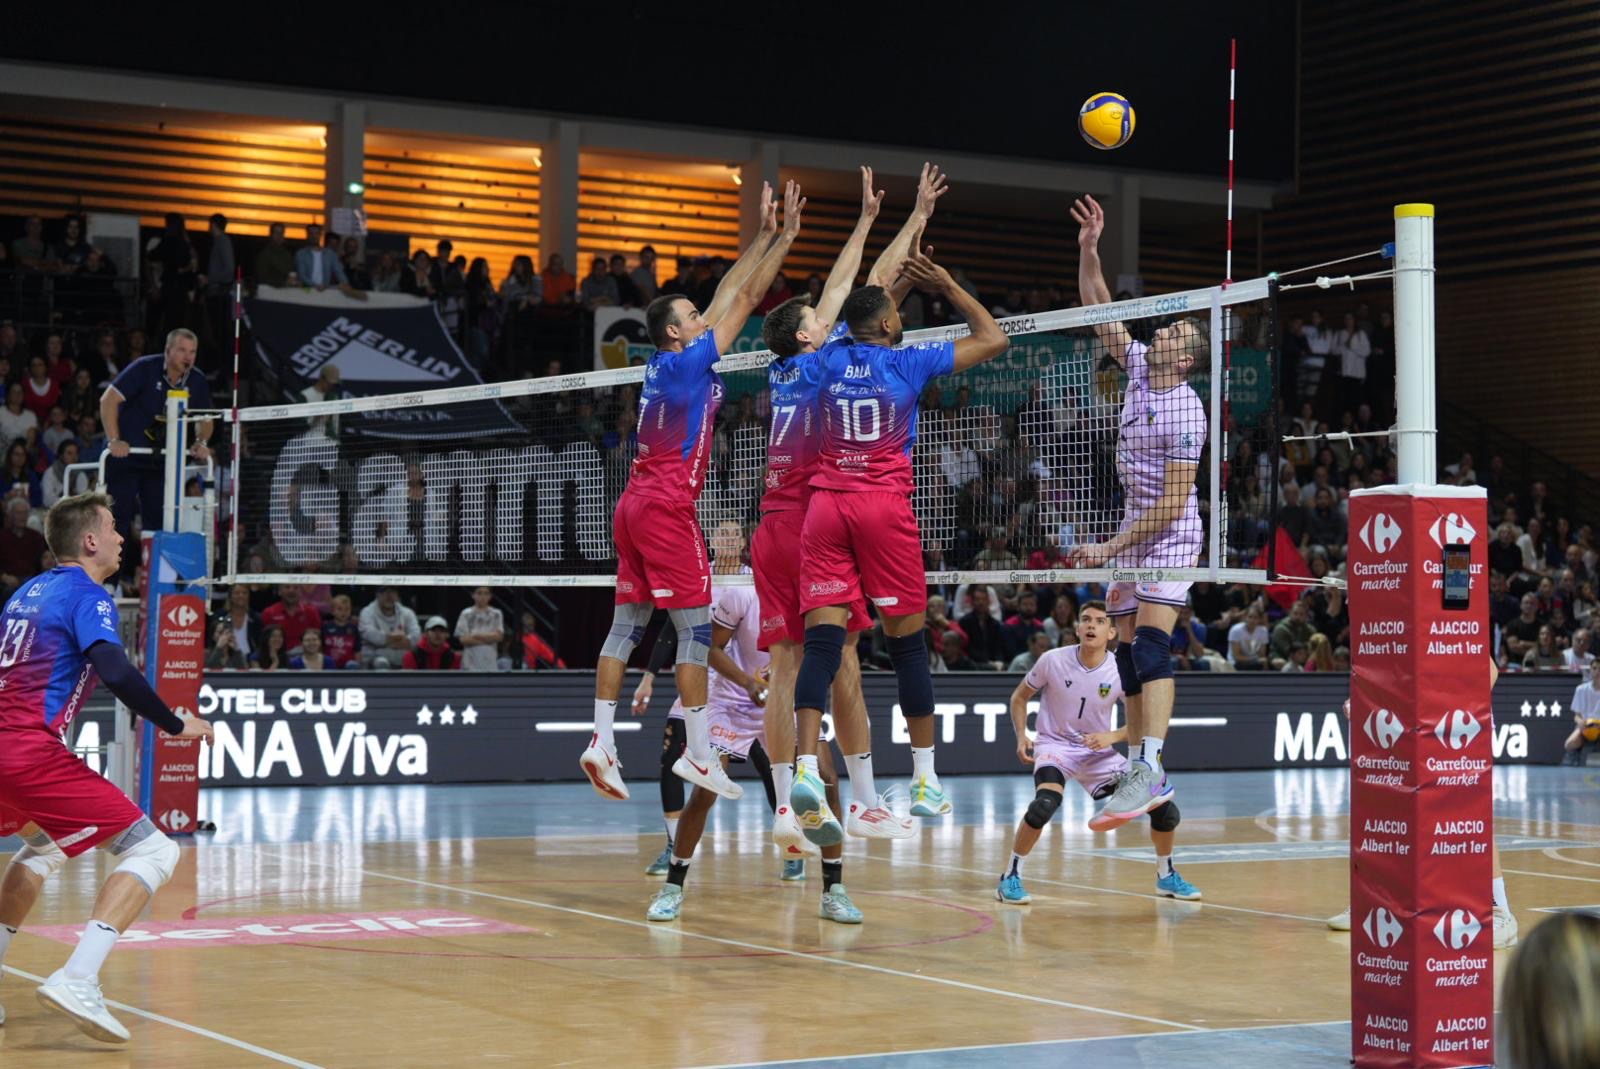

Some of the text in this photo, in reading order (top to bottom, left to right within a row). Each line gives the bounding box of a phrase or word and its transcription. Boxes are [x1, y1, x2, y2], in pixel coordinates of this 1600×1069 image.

[1155, 296, 1188, 314] CORSE
[290, 316, 462, 378] LEROY MERLIN
[844, 364, 872, 379] BALA
[561, 377, 587, 389] CORSICA
[769, 404, 797, 446] 17
[836, 398, 880, 441] 10
[270, 435, 611, 563] Gamm
[1353, 560, 1408, 575] Carrefour
[1010, 571, 1047, 582] Gamm vert
[1112, 570, 1153, 581] Gamm vert
[701, 576, 709, 592] 7
[1361, 577, 1400, 590] market
[162, 629, 201, 639] Carrefour
[1360, 621, 1405, 635] AJACCIO
[1429, 621, 1479, 635] AJACCIO
[167, 638, 197, 647] market
[1358, 641, 1408, 655] Albert 1er
[1427, 642, 1483, 654] Albert 1er
[164, 660, 198, 669] AJACCIO
[162, 671, 186, 679] Albert
[64, 664, 92, 723] CORSICA
[198, 684, 367, 714] ÔTEL CLUB
[1078, 697, 1086, 719] 1
[1273, 712, 1350, 761] MA
[1491, 723, 1528, 758] va
[314, 722, 428, 777] Viva
[1356, 755, 1410, 771] Carrefour
[1426, 755, 1486, 771] Carrefour
[159, 774, 183, 782] Albert
[1365, 773, 1404, 786] market
[1437, 773, 1480, 785] market
[1364, 819, 1407, 835] AJACCIO
[1434, 820, 1484, 835] AJACCIO
[1361, 839, 1410, 855] Albert 1er
[1431, 840, 1487, 855] Albert 1er
[78, 917, 489, 943] Betclic
[1357, 952, 1409, 971] Carrefour
[1426, 956, 1488, 972] Carrefour
[1364, 972, 1402, 986] market
[1435, 973, 1479, 987] market
[1365, 1014, 1409, 1032] AJACCIO
[1435, 1016, 1487, 1032] AJACCIO
[1363, 1033, 1411, 1052] Albert 1er
[1432, 1037, 1490, 1052] Albert 1er
